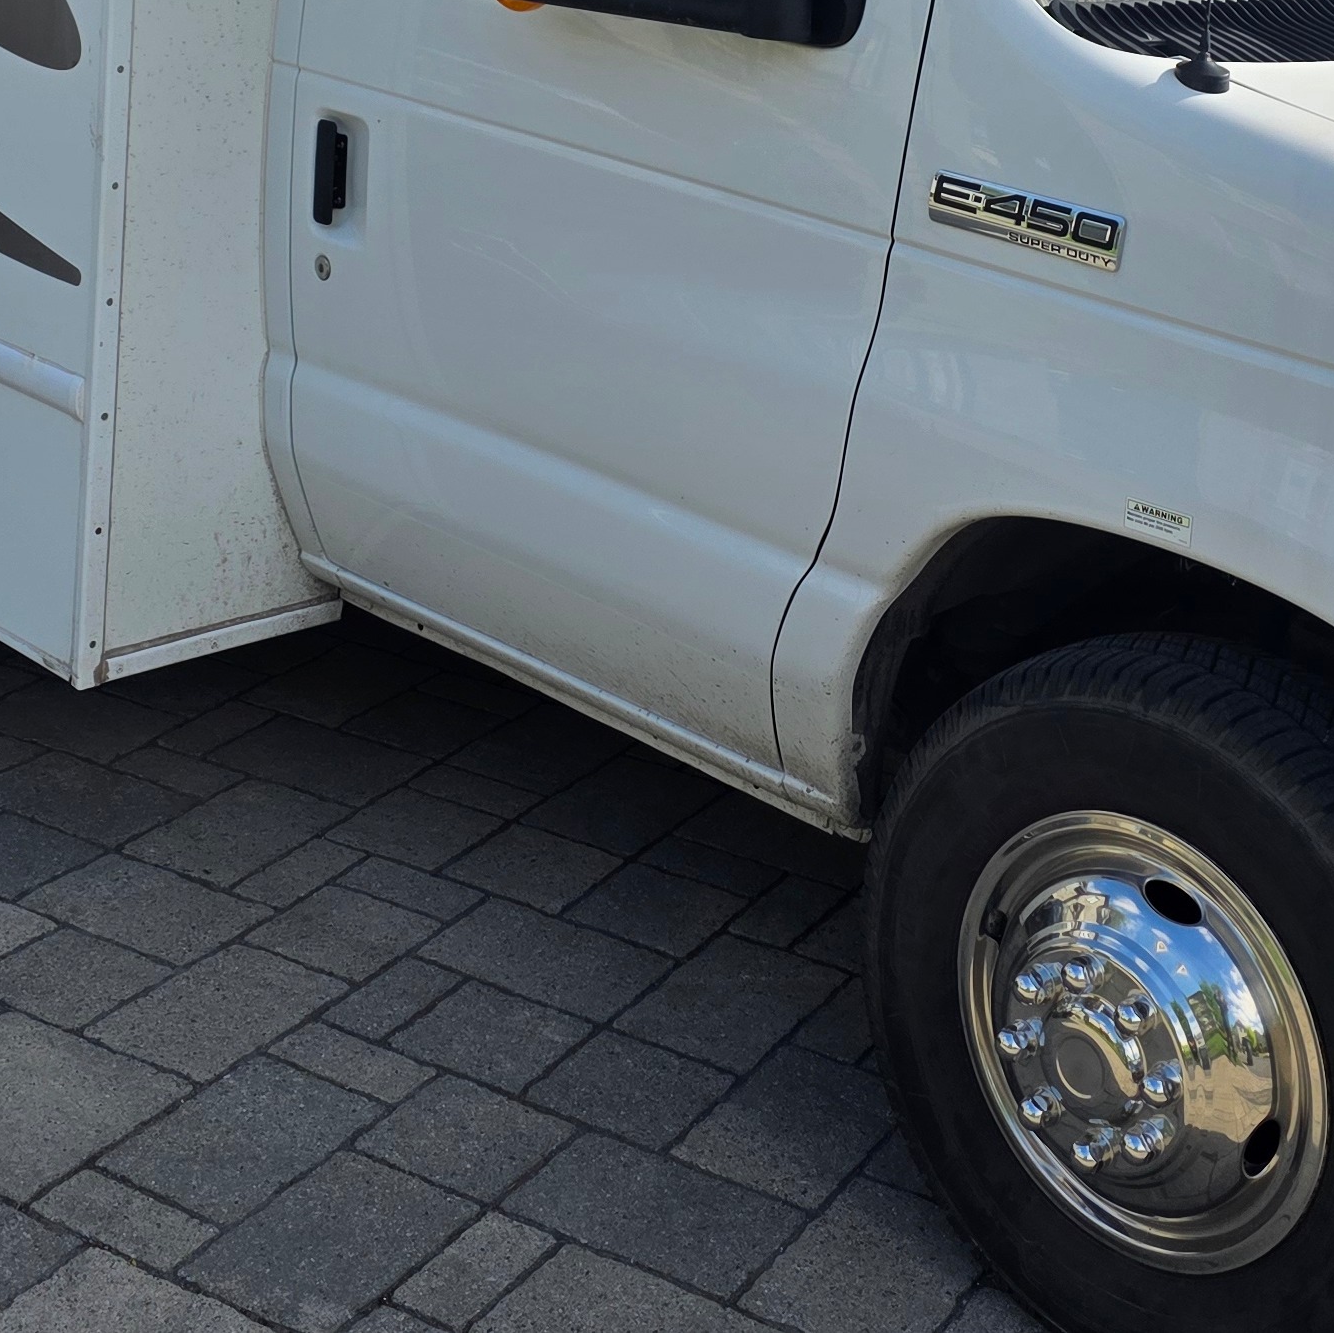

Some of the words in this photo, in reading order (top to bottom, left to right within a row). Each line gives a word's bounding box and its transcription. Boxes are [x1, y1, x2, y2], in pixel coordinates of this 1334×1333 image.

[933, 173, 1119, 251] E-450
[1008, 231, 1061, 254] SUPER
[1067, 248, 1111, 267] DUTY
[1141, 505, 1183, 524] WARNING
